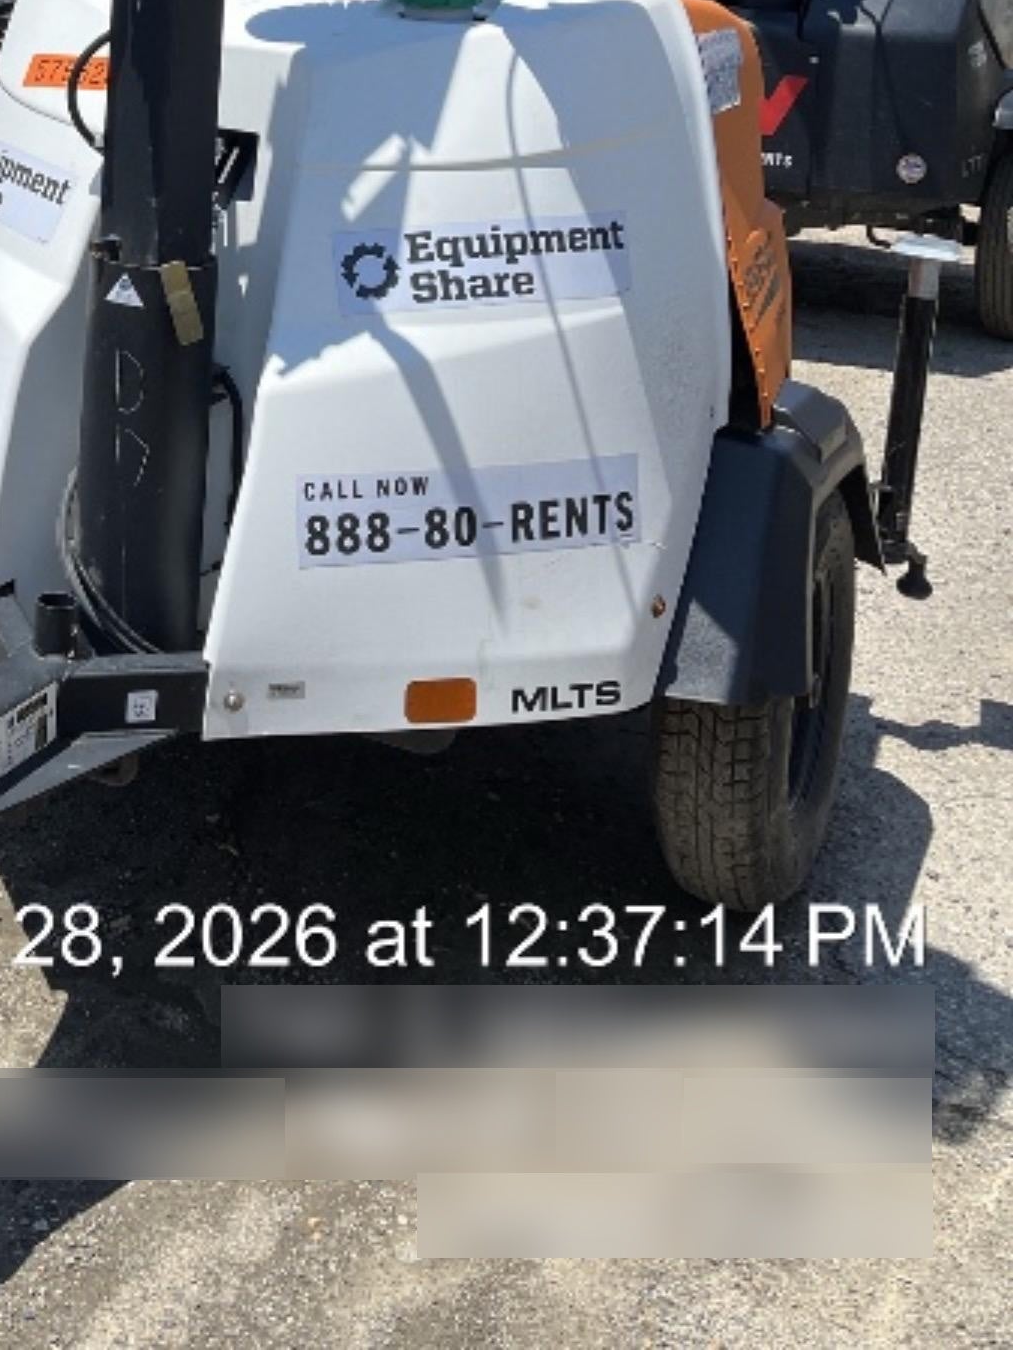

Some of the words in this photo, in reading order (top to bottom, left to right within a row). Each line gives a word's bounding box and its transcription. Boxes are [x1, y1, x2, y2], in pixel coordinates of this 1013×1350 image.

[404, 221, 624, 267] Equipment
[410, 269, 534, 303] Share
[304, 479, 363, 501] CALL
[376, 476, 429, 497] NOW
[305, 491, 633, 556] 888-80-RENTS
[511, 680, 621, 714] MLTS
